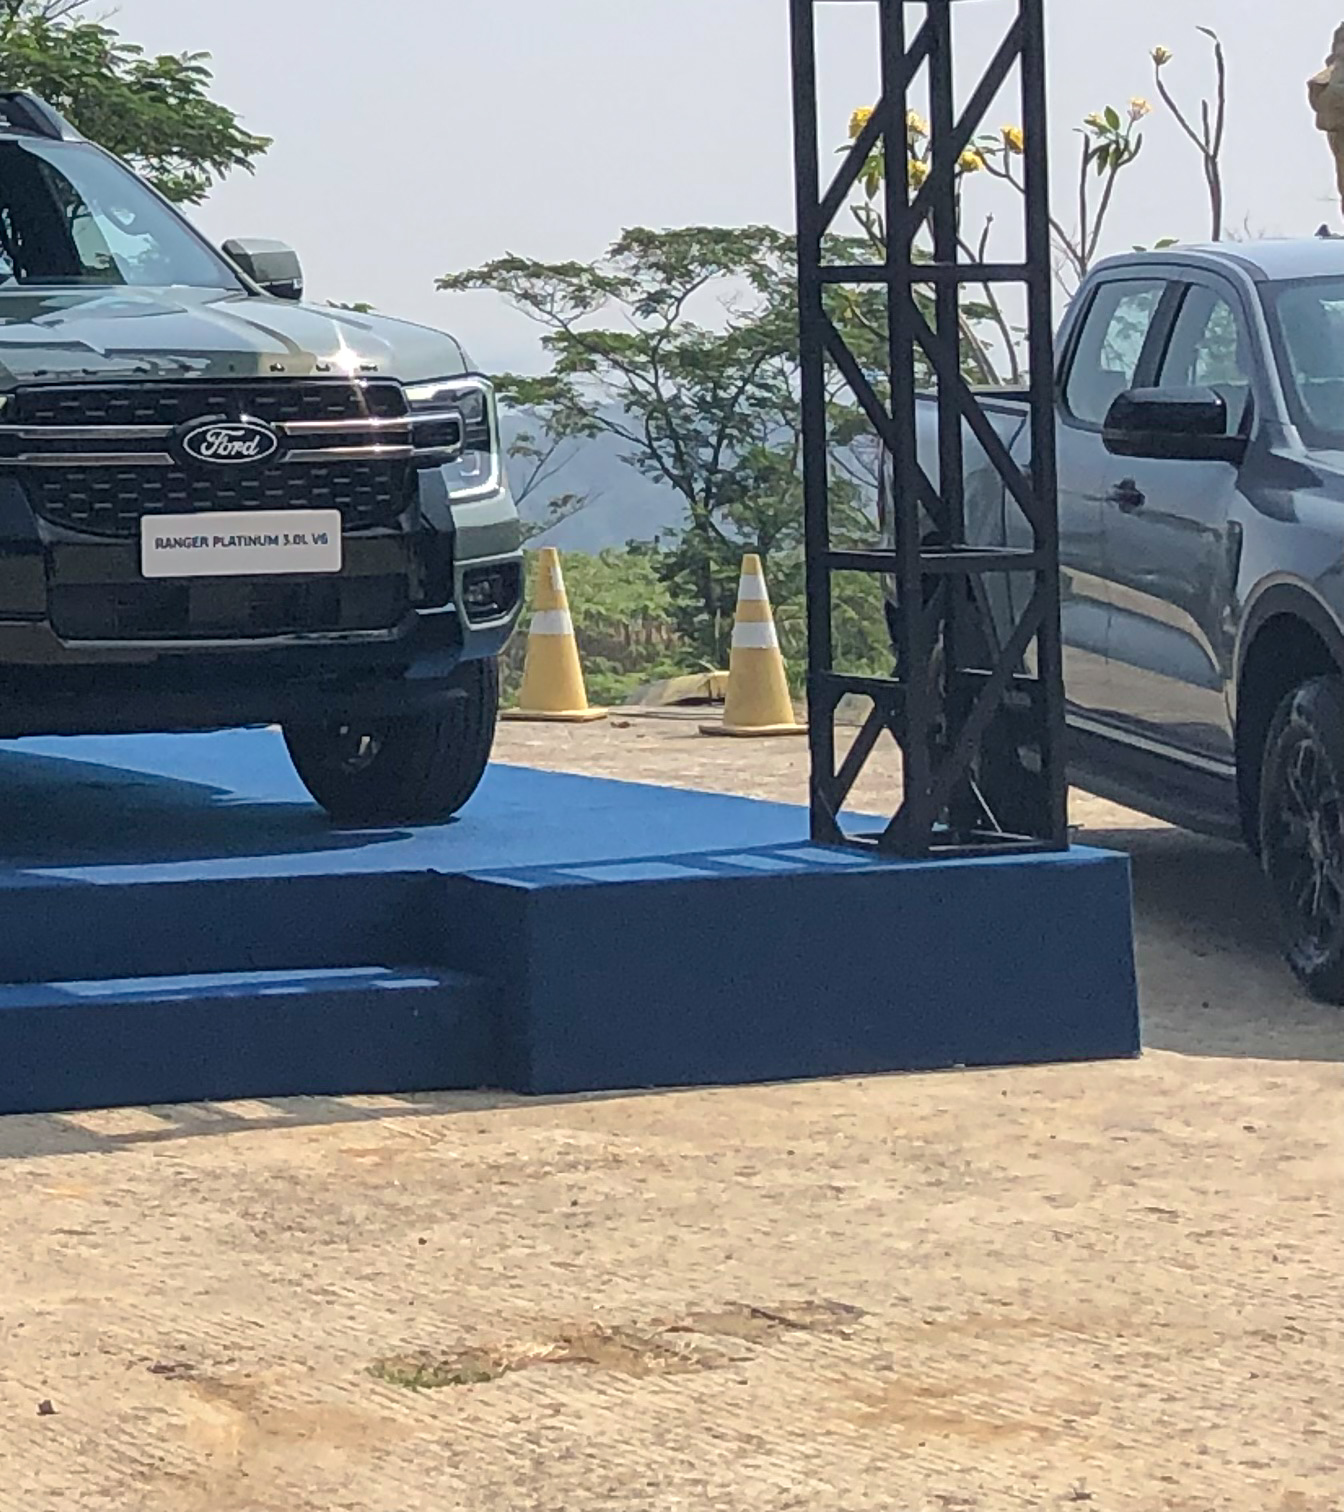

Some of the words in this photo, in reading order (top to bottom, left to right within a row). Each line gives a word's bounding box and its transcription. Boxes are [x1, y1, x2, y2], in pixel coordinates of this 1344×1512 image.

[199, 428, 261, 456] Ford
[154, 535, 210, 550] RANGER
[212, 534, 280, 548] PLATINUM
[283, 533, 309, 546] 3.0L
[311, 532, 329, 545] V6
